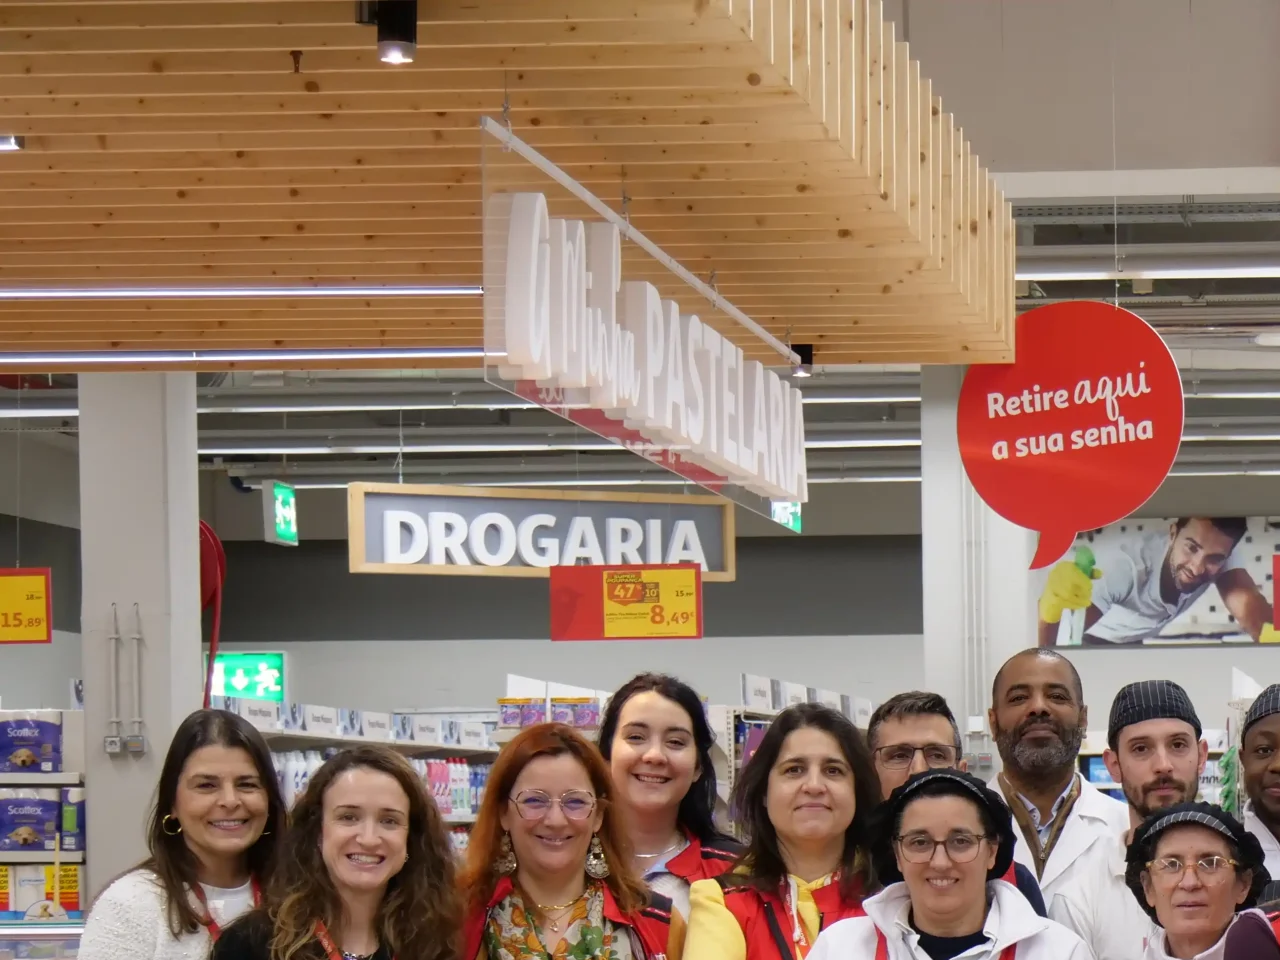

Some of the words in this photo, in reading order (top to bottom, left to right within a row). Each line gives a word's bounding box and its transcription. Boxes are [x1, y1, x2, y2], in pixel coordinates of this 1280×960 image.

[640, 281, 808, 502] PASTELARIA
[987, 384, 1069, 419] Retire
[1073, 361, 1152, 421] aqui
[991, 440, 1009, 460] a
[1015, 432, 1064, 458] sua
[1071, 416, 1154, 450] senha
[382, 510, 709, 572] DROGARIA
